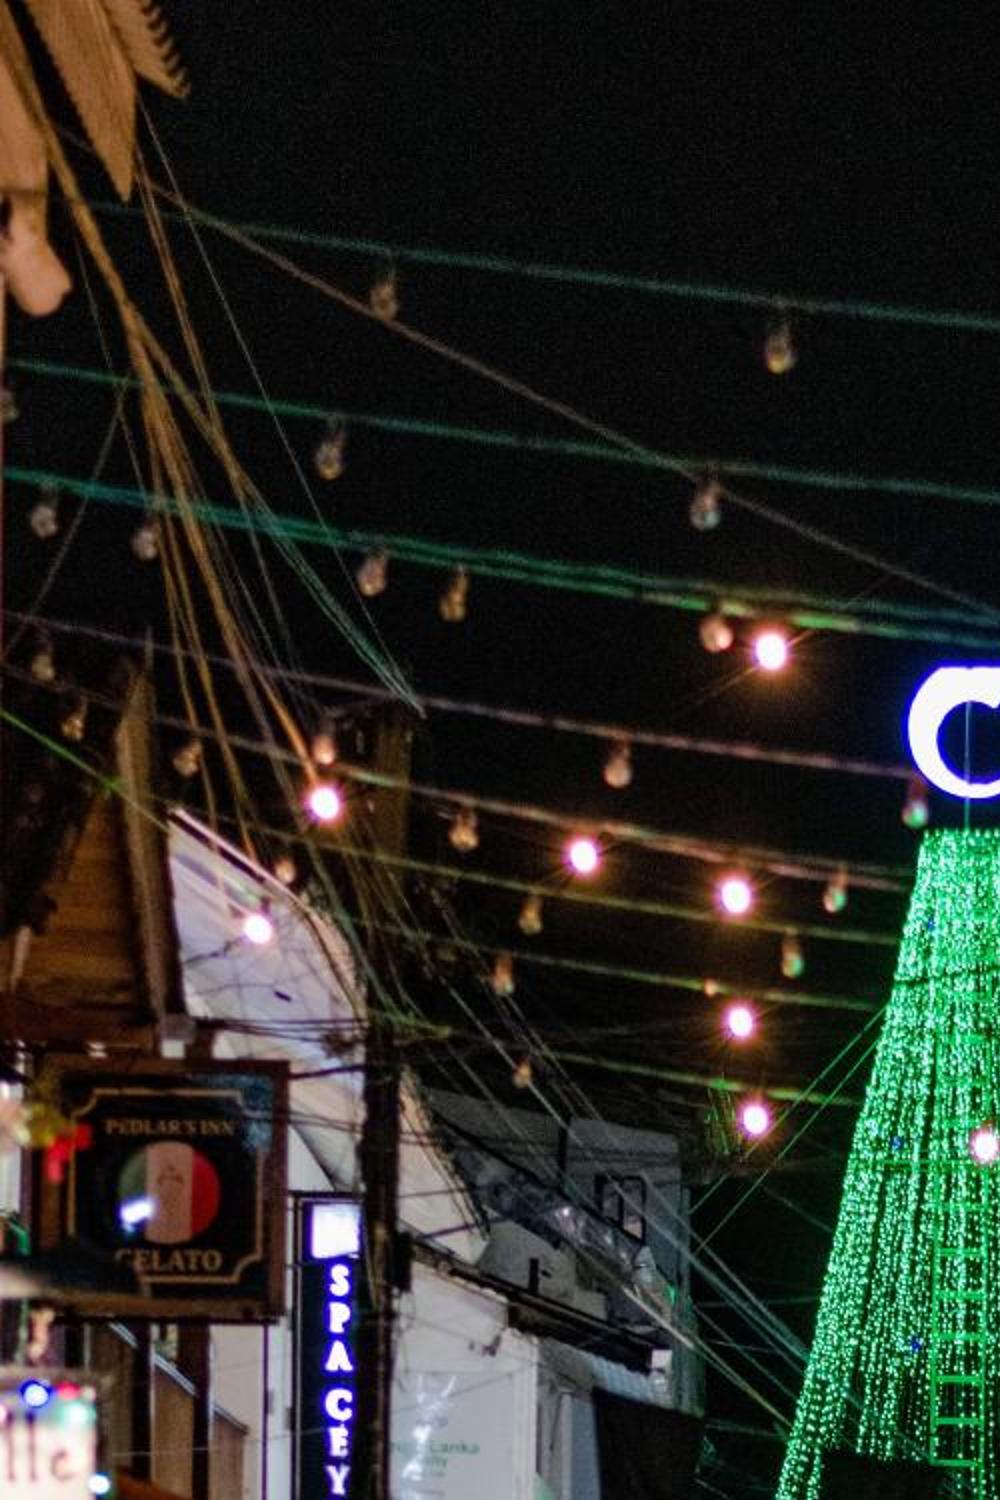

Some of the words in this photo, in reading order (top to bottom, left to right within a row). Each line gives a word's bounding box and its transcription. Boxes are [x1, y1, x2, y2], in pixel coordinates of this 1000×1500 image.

[105, 1118, 196, 1136] PEDLAR'S
[200, 1118, 234, 1136] INN
[324, 1263, 354, 1373] SPA
